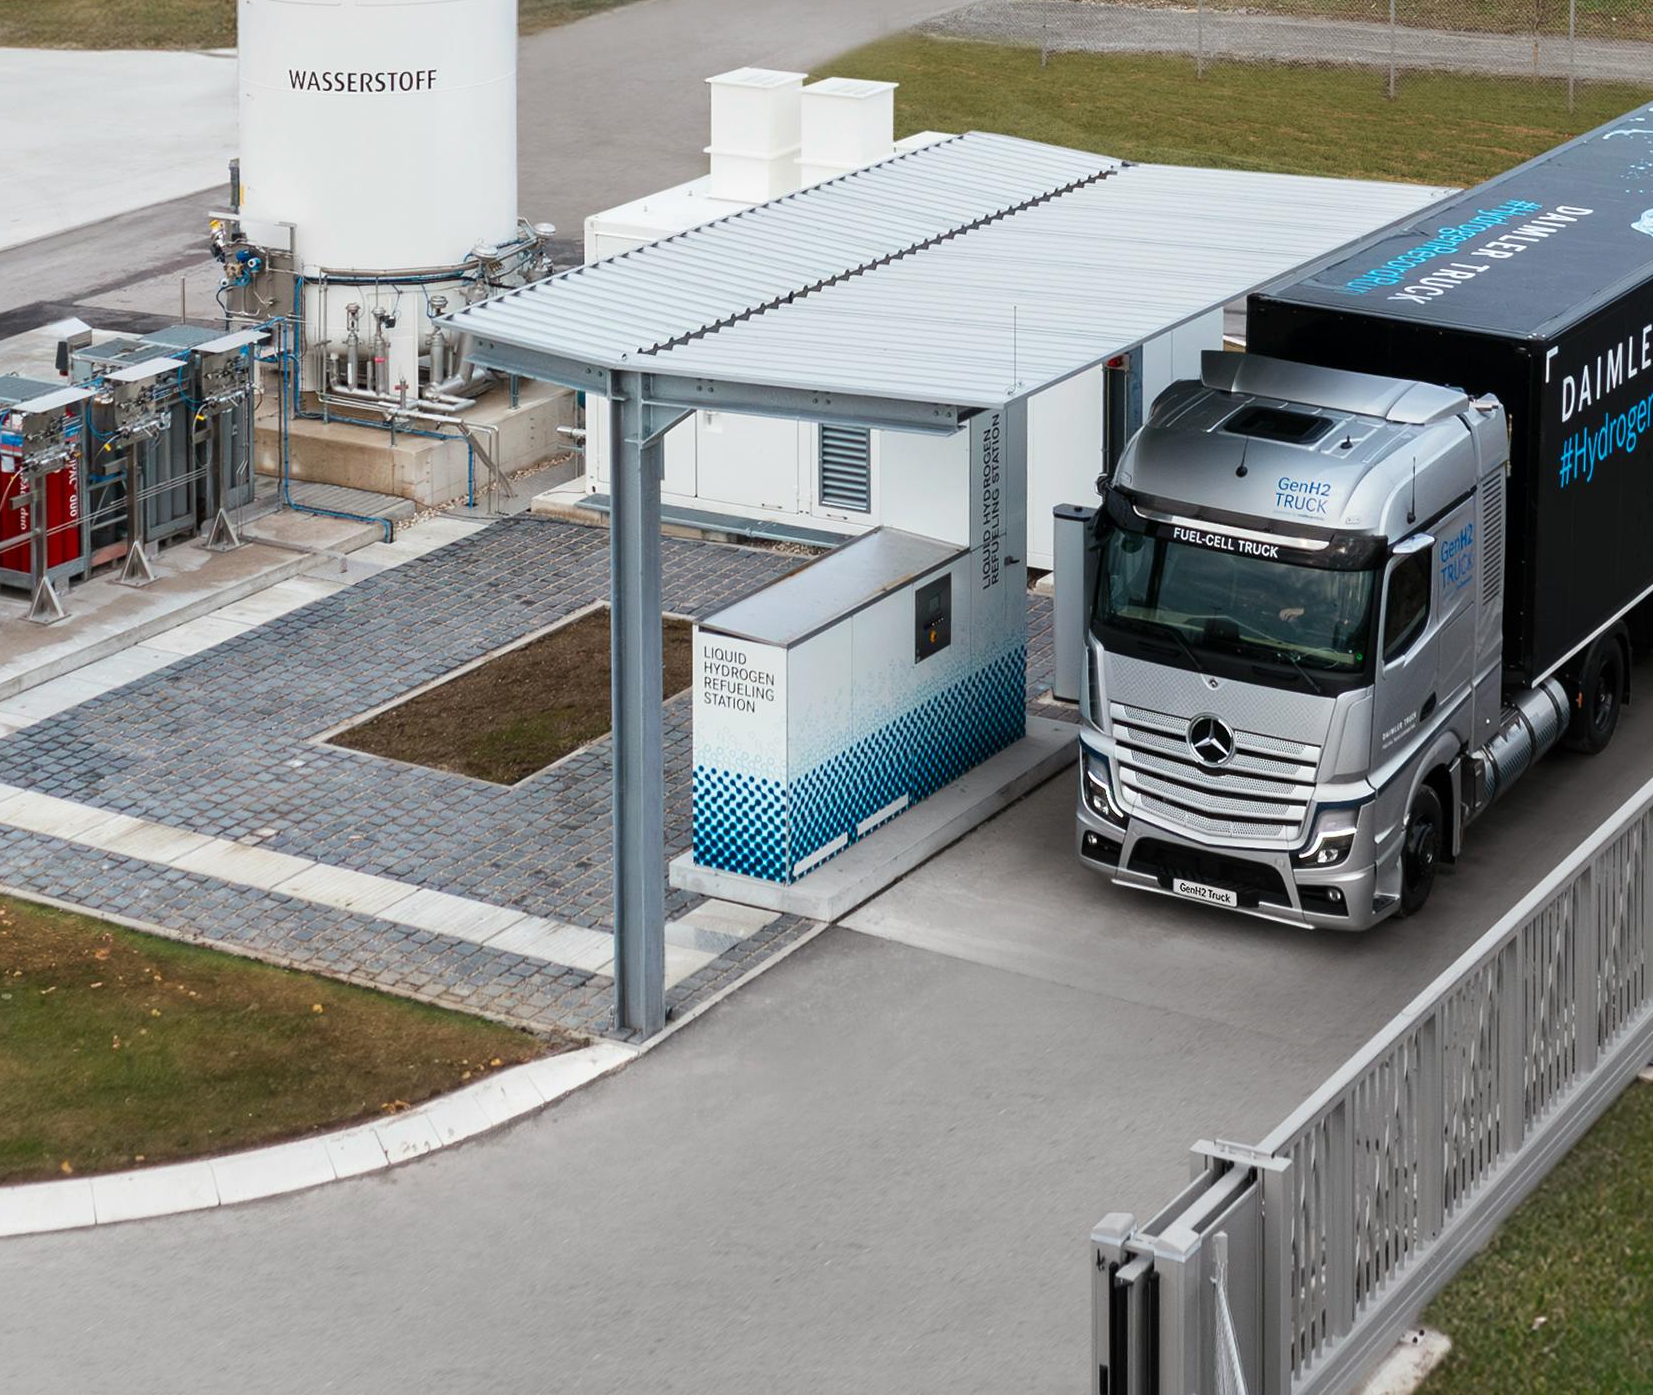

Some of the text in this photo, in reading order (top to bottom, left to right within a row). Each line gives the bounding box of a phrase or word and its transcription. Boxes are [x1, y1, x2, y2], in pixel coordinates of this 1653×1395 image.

[289, 69, 437, 93] WASSERSTOFF
[1387, 205, 1595, 305] DAIMLER TRUCK
[991, 414, 1000, 585] REFUELING STATION
[1278, 476, 1331, 497] GenH2
[982, 429, 992, 590] LIQUID HYDROGEN
[1275, 492, 1329, 515] TRUCK
[1173, 527, 1279, 559] FUEL-CELL TRUCK
[1440, 523, 1474, 563] GenH2
[704, 645, 747, 666] LIQUID
[704, 660, 775, 687] HYDROGEN
[704, 676, 775, 702] REFUELING
[704, 691, 755, 713] STATION
[1179, 882, 1231, 904] GenH2 Truck
